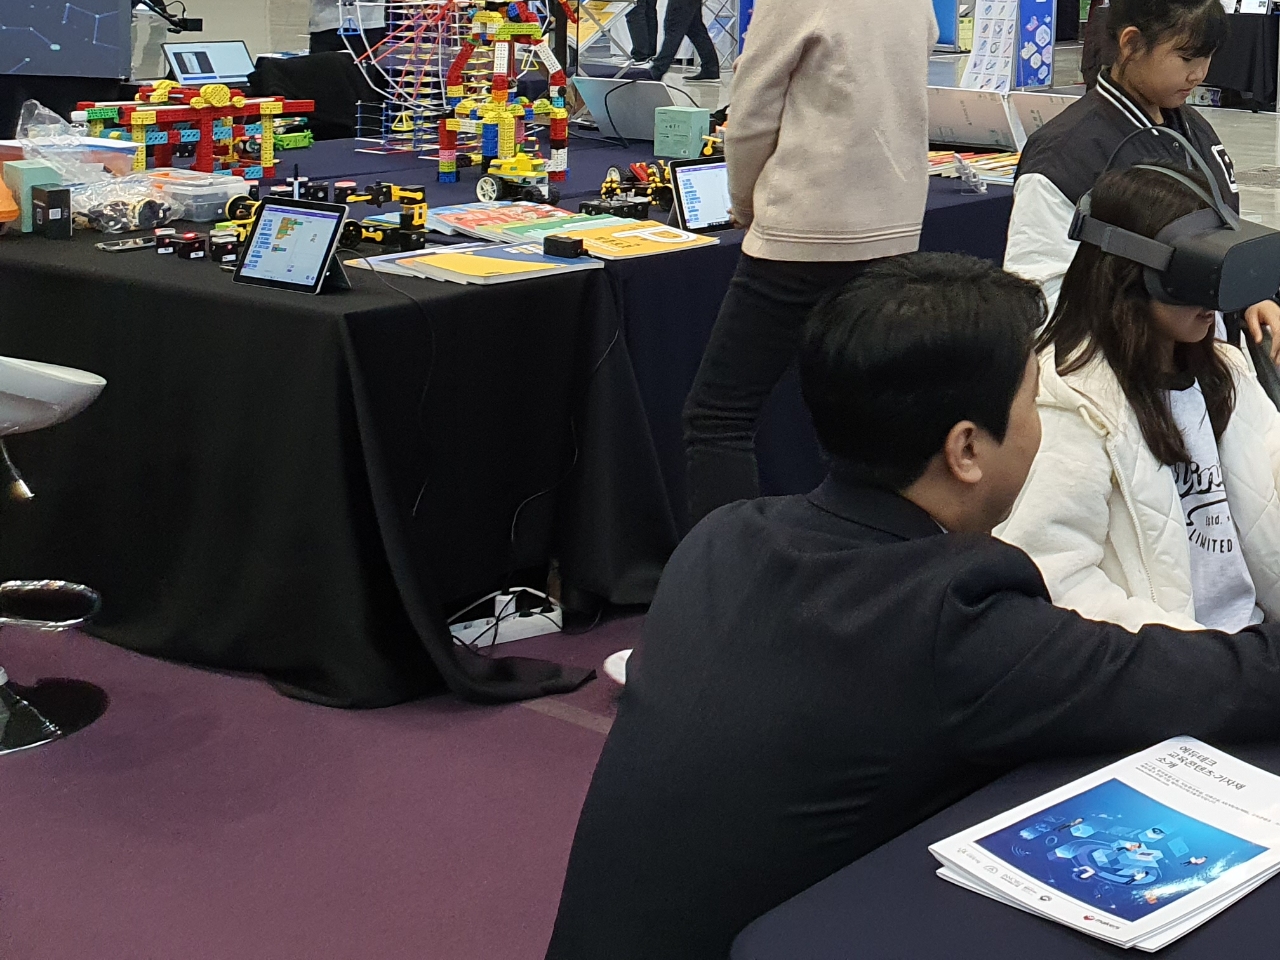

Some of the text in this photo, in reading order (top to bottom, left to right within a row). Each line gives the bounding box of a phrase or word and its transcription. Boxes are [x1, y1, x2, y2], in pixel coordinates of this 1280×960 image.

[1188, 528, 1233, 553] LIMITED
[1155, 756, 1178, 769] 소개
[1179, 745, 1218, 767] 에듀테크
